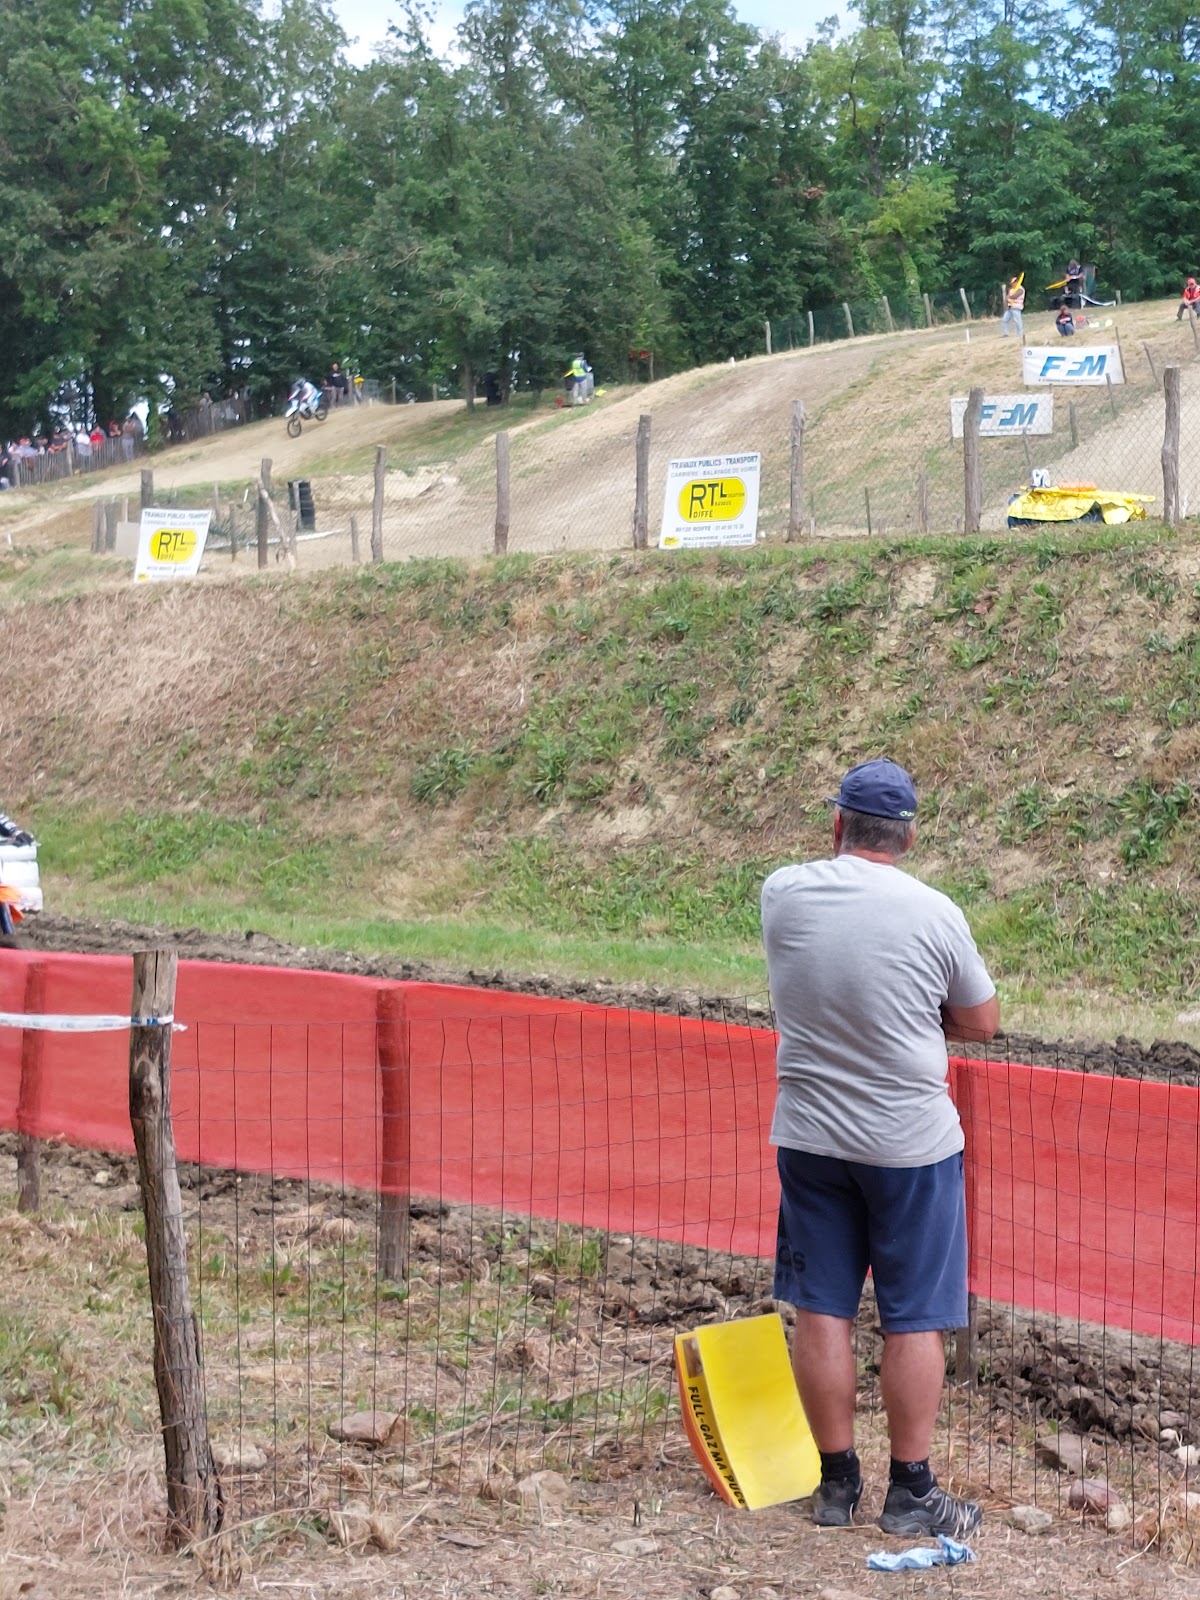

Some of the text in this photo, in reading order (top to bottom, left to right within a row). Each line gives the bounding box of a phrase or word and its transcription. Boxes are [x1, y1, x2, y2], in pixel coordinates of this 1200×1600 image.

[698, 458, 722, 468] PUBLICS
[725, 455, 758, 464] TRANSPORT
[688, 1386, 718, 1449] FULL-GAZ
[710, 1451, 728, 1470] MA
